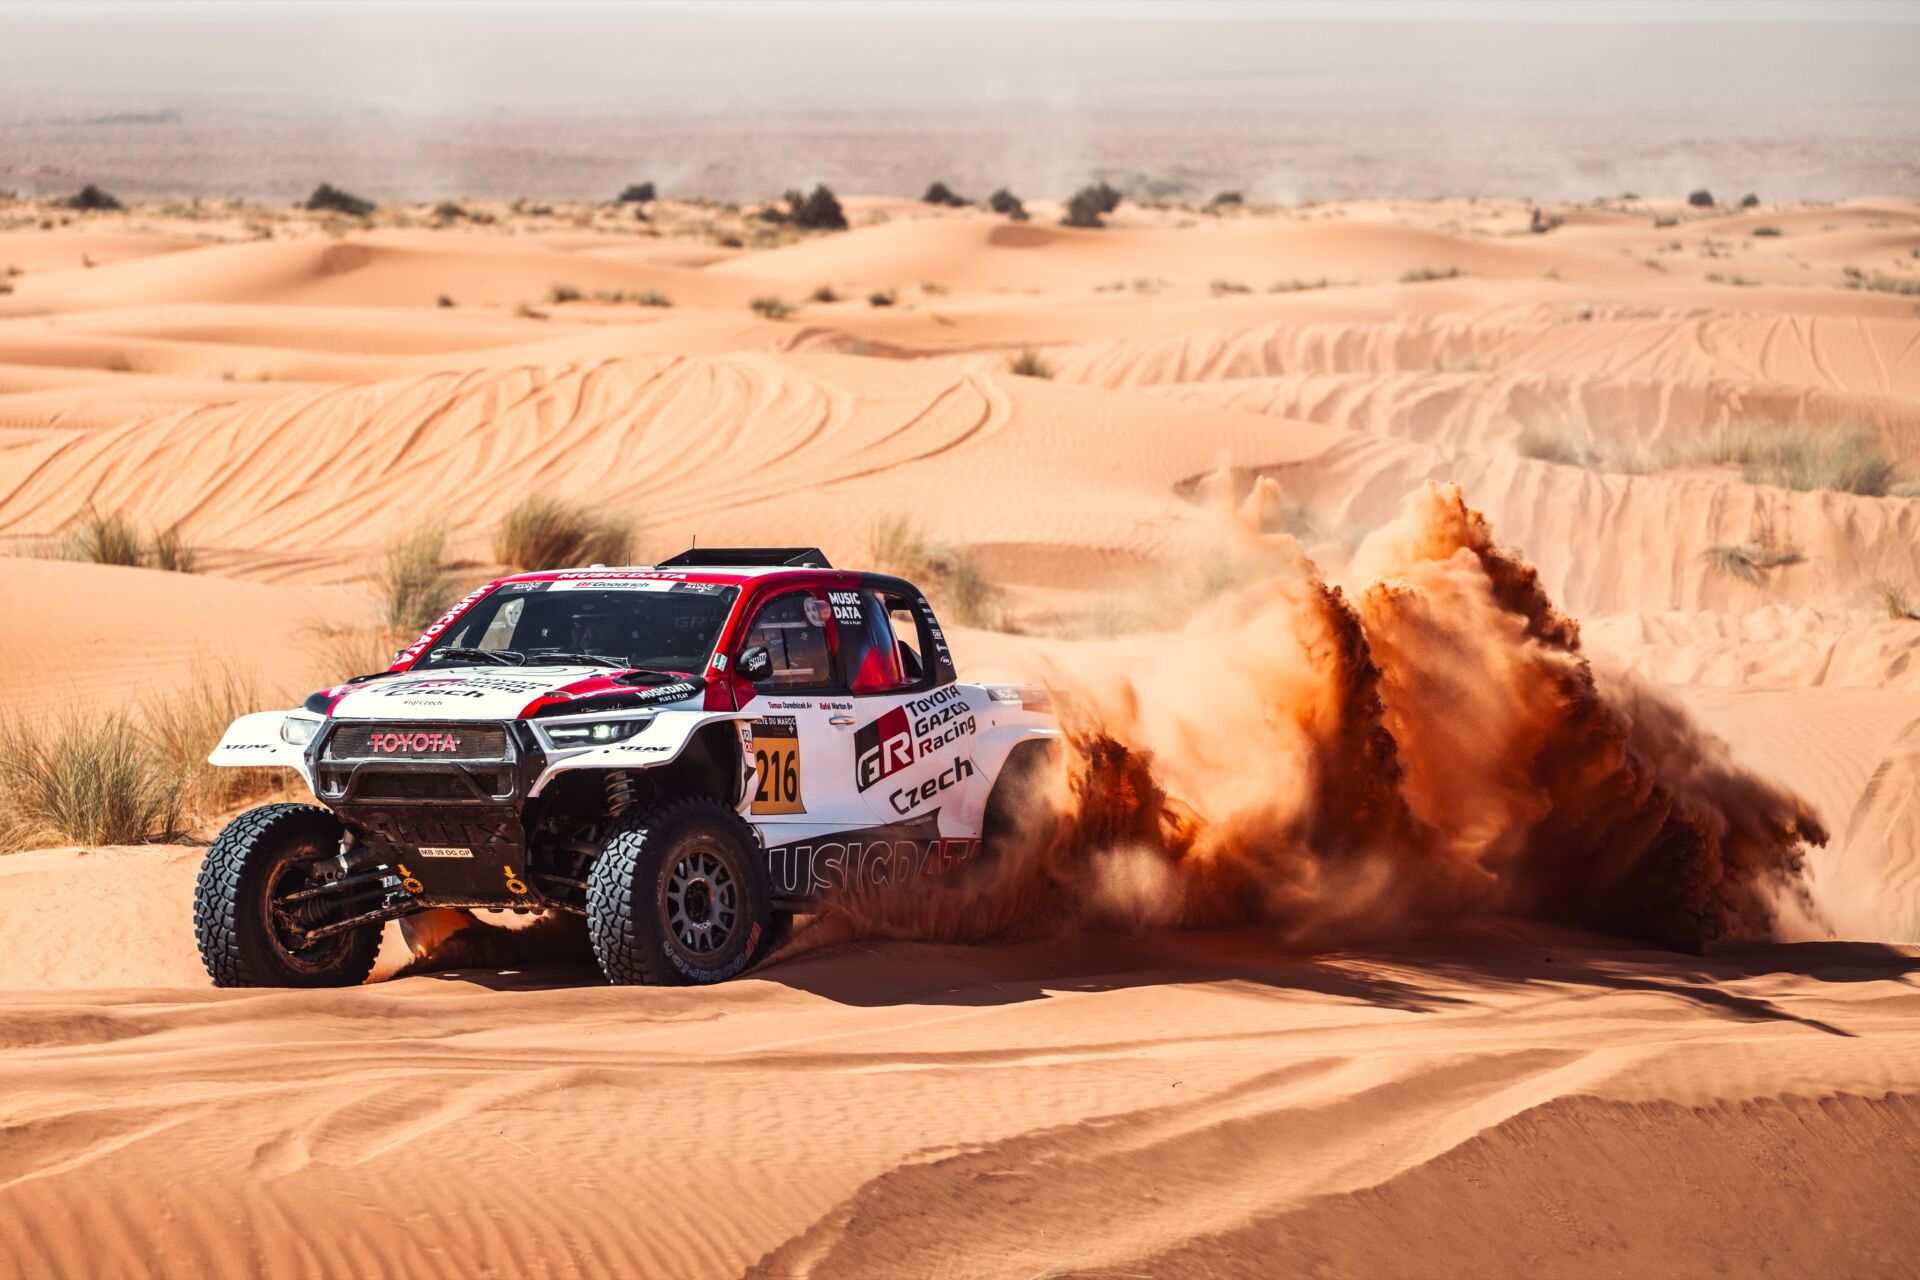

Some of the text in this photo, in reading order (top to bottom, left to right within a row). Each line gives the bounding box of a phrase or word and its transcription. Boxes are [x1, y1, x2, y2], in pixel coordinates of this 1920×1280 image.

[828, 592, 861, 605] MUSIC
[833, 606, 862, 619] DATA
[393, 584, 495, 665] MUSICDATA
[384, 689, 485, 698] Czech
[636, 682, 696, 700] MUSICDATA
[905, 684, 962, 717] TOYOTA
[769, 717, 776, 725] DU
[776, 717, 796, 726] MAROC
[914, 701, 970, 738] GAZOO
[371, 734, 458, 753] TOYOTA
[918, 715, 976, 758] Racing
[755, 749, 797, 802] 216
[857, 731, 912, 788] GR
[889, 756, 974, 815] Czech
